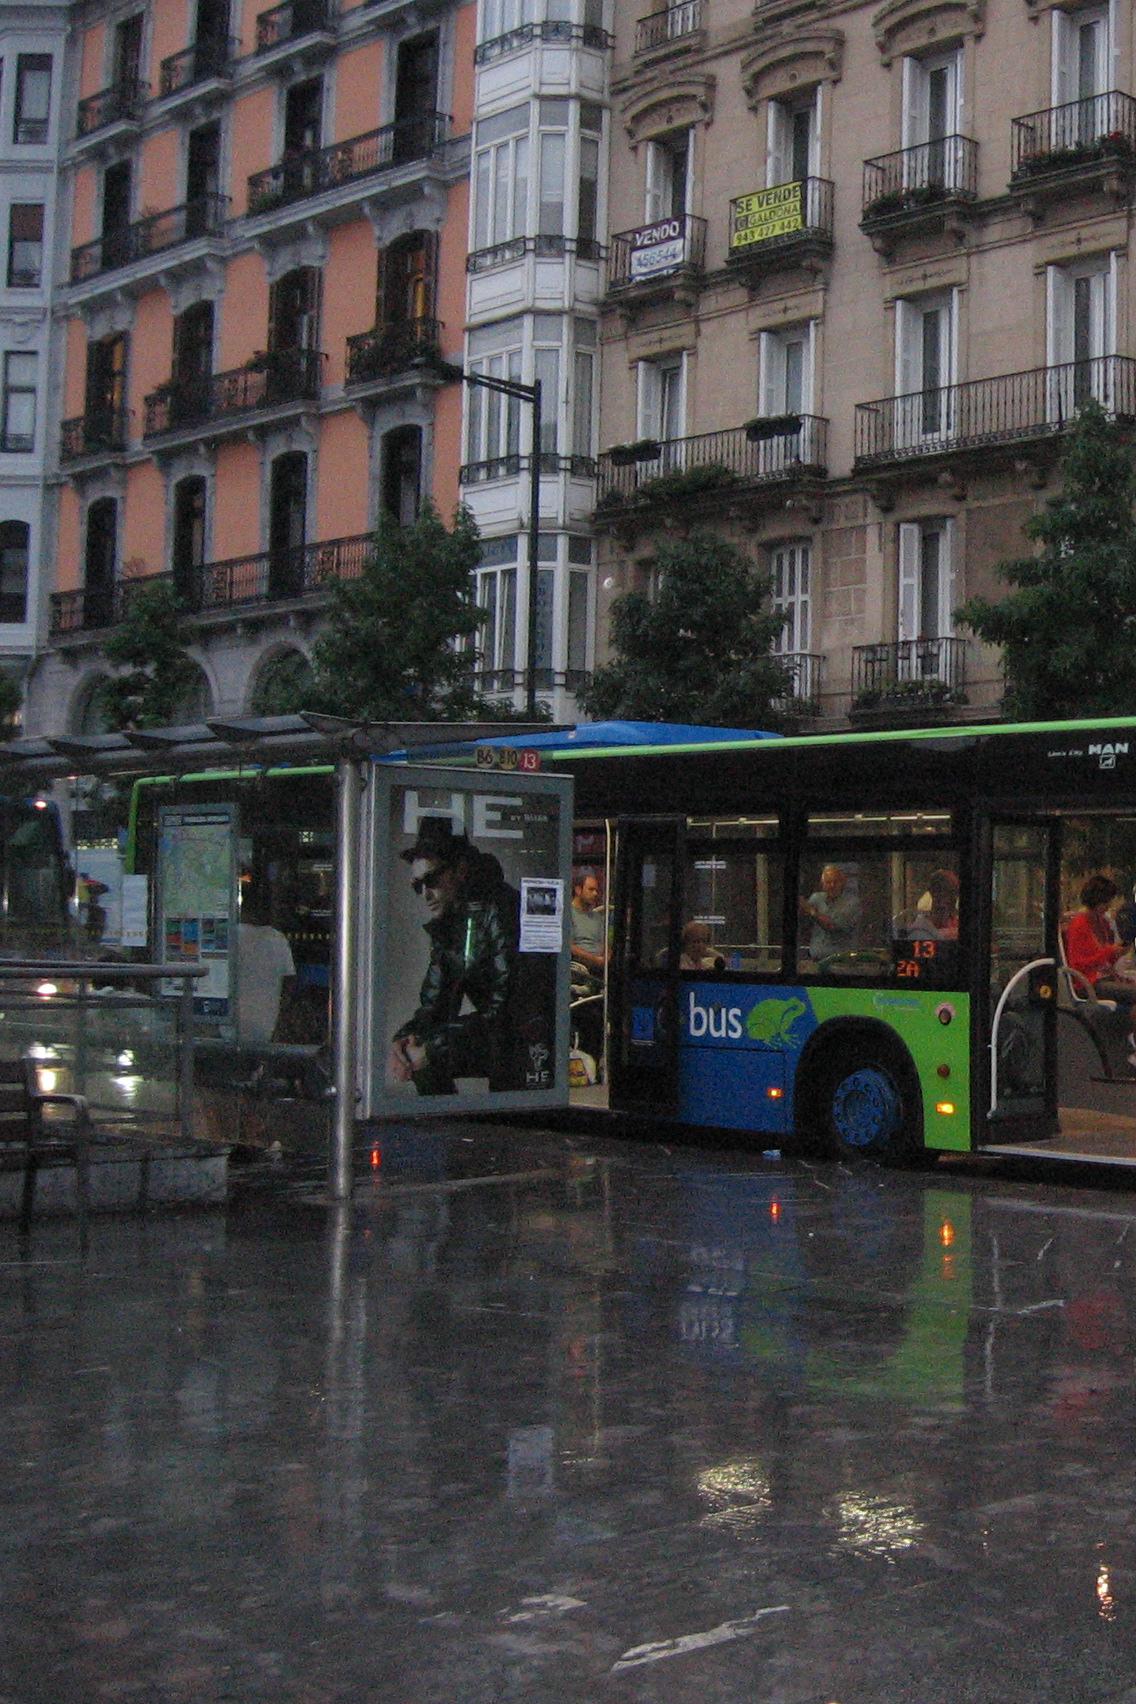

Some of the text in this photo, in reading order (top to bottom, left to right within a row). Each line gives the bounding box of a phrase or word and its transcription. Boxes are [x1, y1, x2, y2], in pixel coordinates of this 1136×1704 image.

[736, 184, 801, 214] SE VENDE
[634, 221, 680, 246] VENDO
[523, 753, 536, 769] 13
[1088, 742, 1129, 755] MAN
[403, 790, 524, 839] HE
[912, 940, 935, 958] 13
[689, 992, 742, 1039] bus
